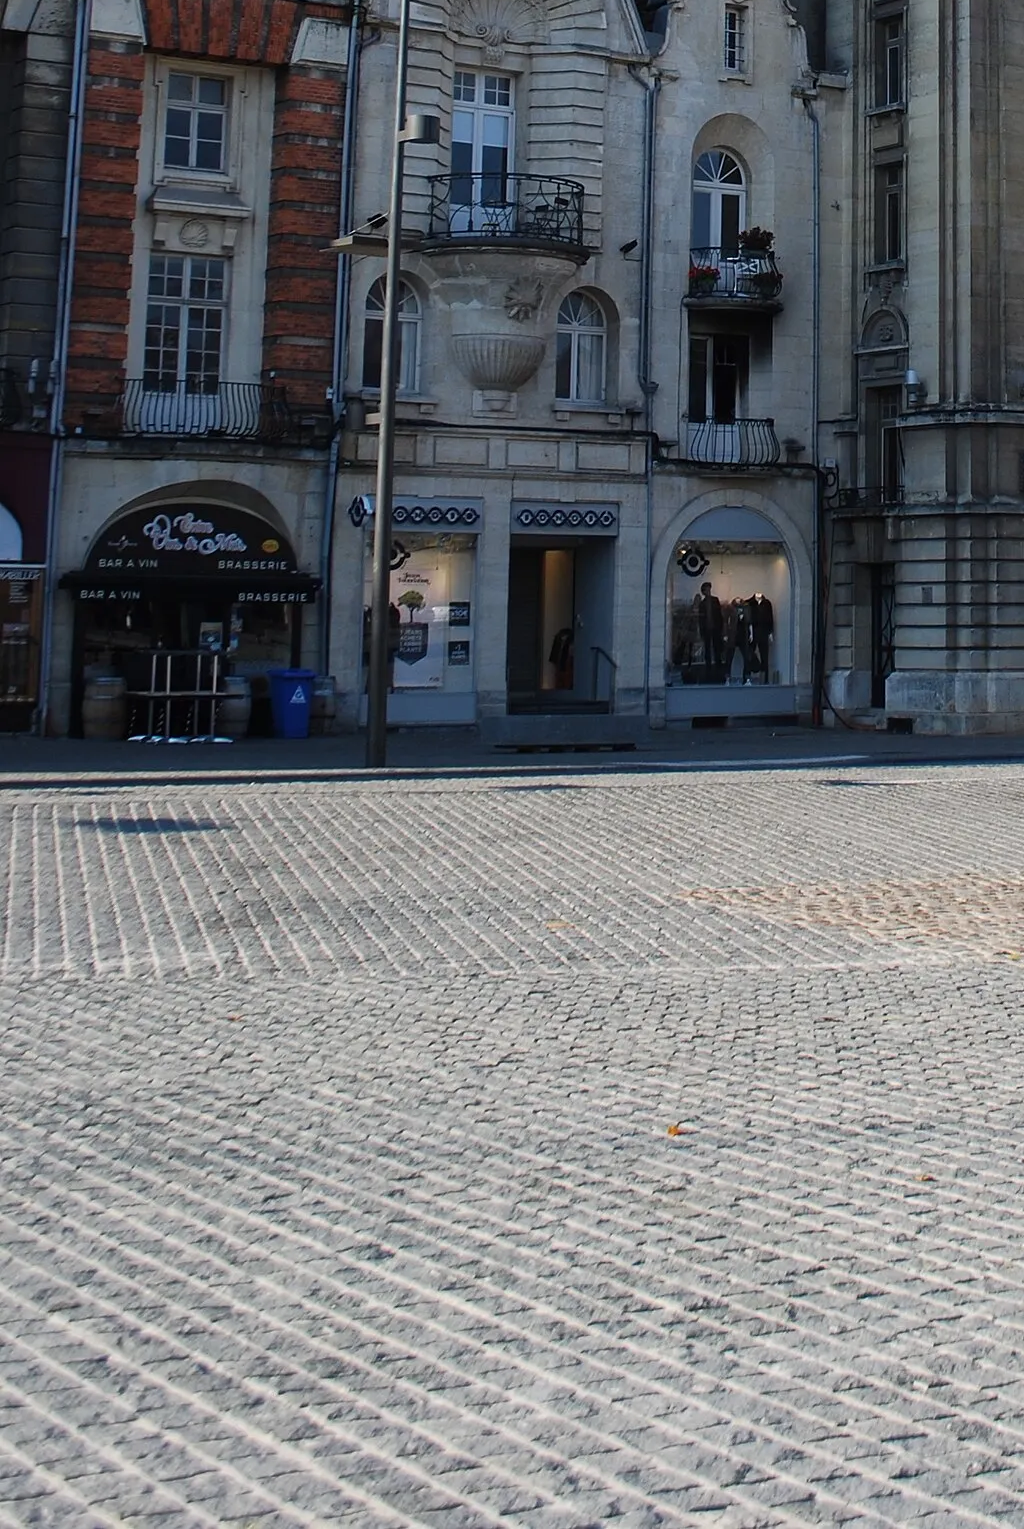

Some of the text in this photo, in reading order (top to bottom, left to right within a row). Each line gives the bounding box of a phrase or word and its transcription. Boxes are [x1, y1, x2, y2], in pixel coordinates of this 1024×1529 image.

[393, 506, 480, 525] ONOBO
[517, 508, 616, 527] BONOBO
[98, 558, 159, 569] BAR A VIN
[217, 560, 288, 570] BRASSERIE
[80, 589, 141, 600] BAR A VIN
[237, 592, 308, 603] BRASSERIE
